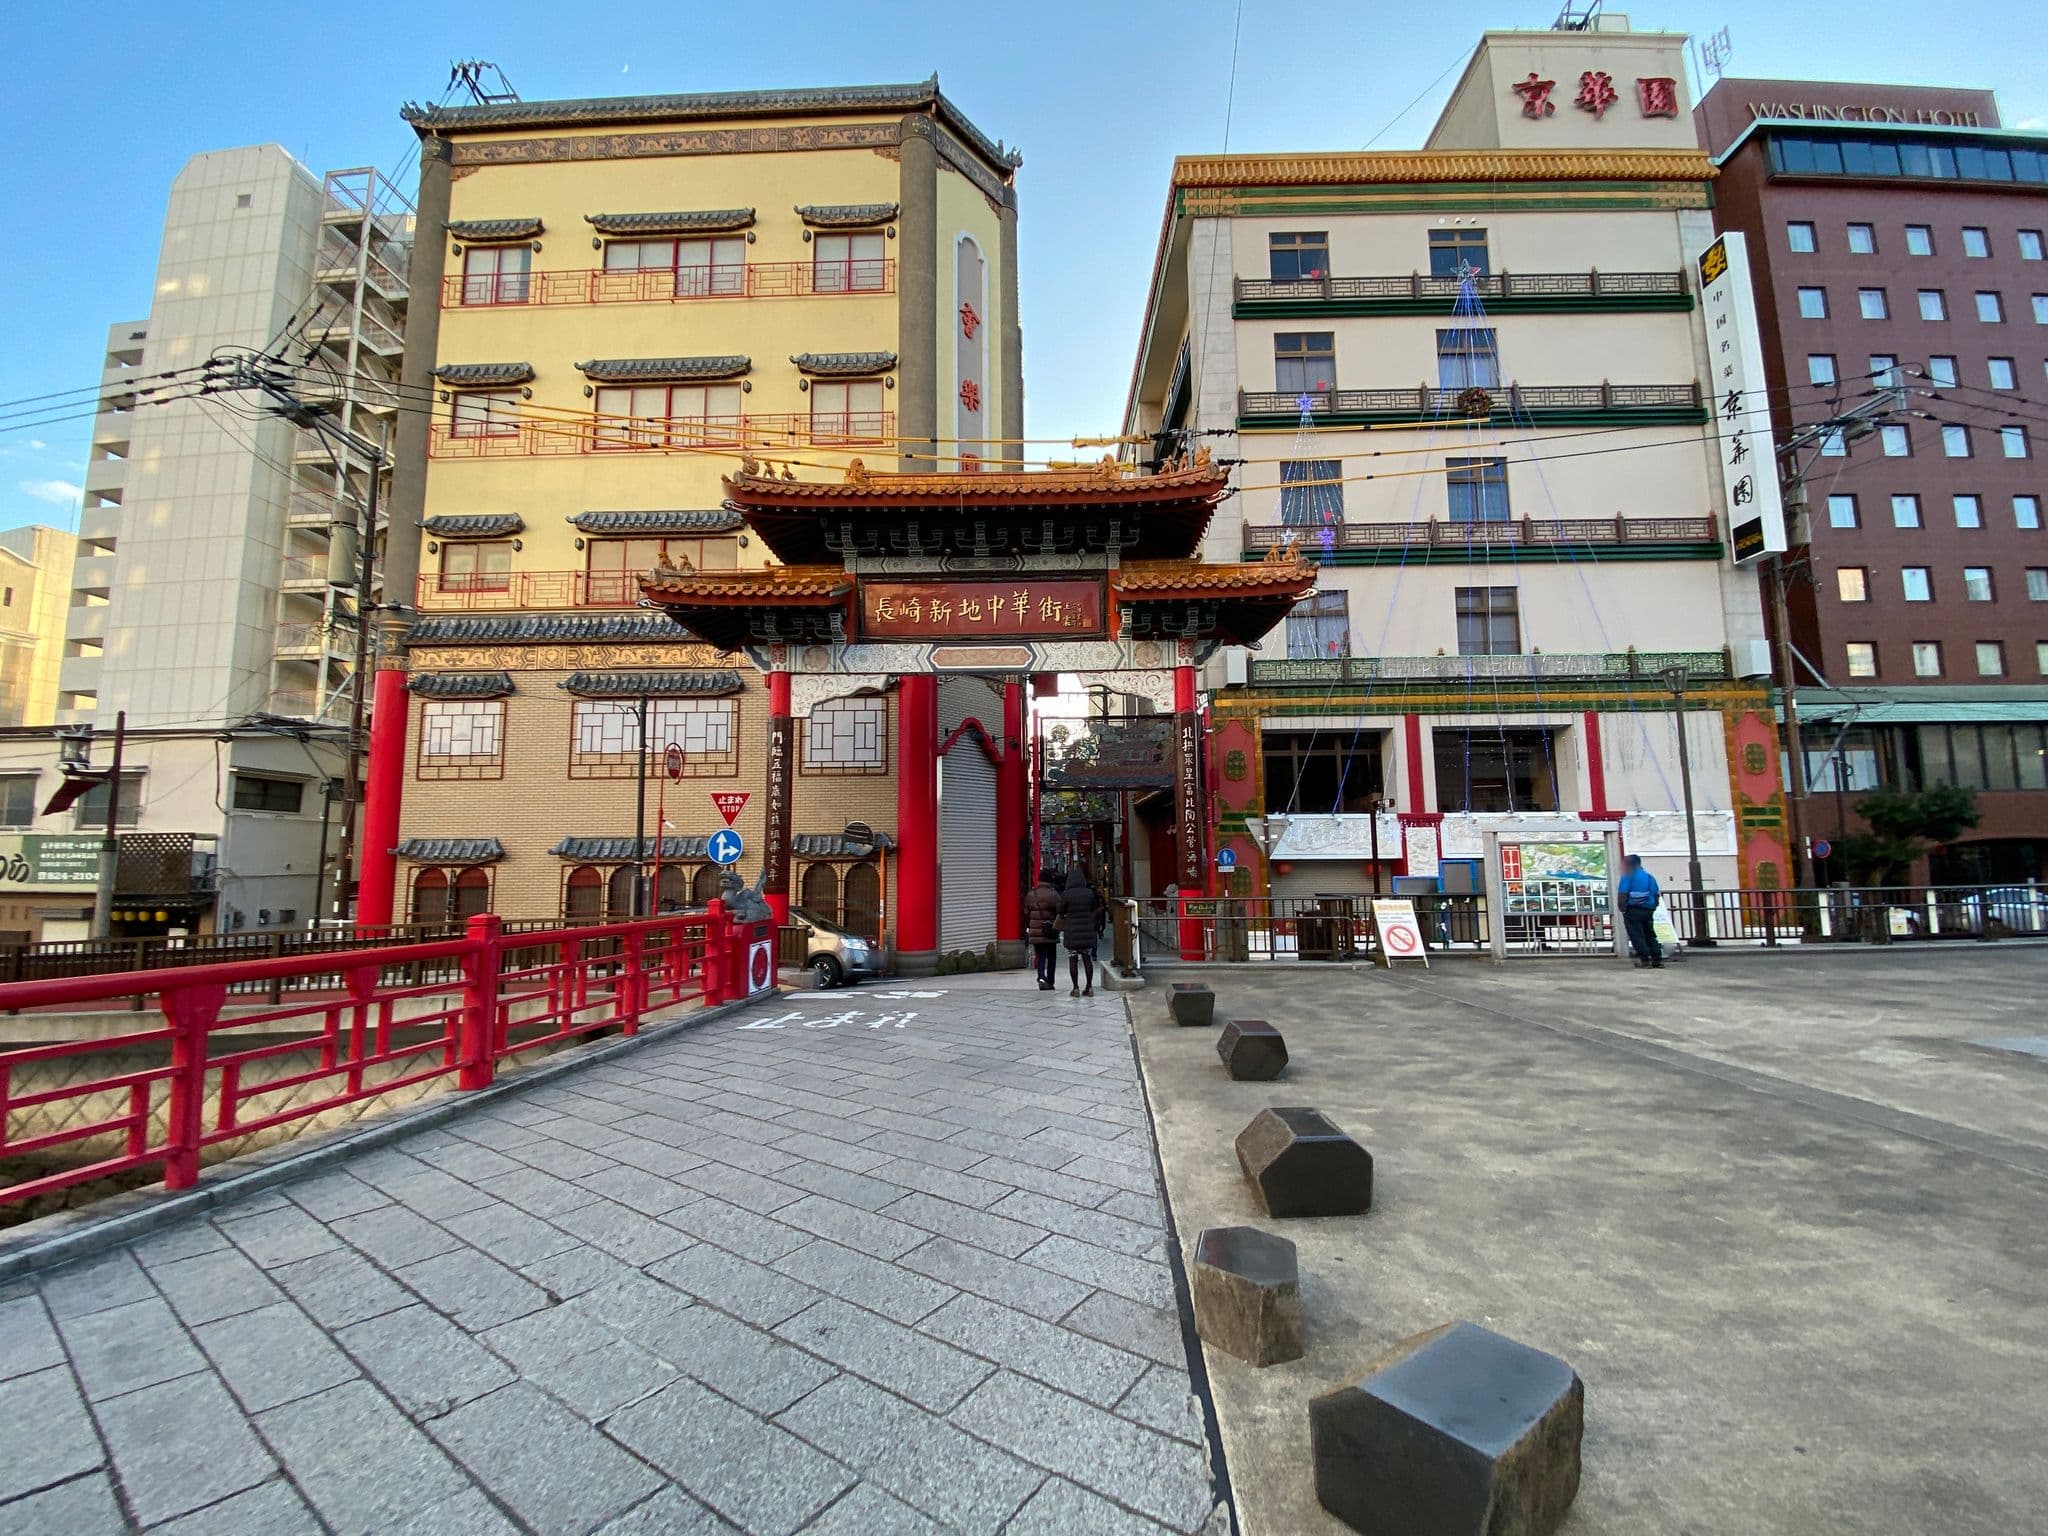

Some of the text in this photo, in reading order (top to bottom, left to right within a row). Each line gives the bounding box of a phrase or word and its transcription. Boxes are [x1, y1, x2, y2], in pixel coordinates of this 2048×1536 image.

[1748, 101, 1908, 123] WASHINGTON
[874, 588, 1062, 628] 長崎新地中華街
[717, 795, 744, 805] 止まれ
[721, 805, 740, 813] STOP
